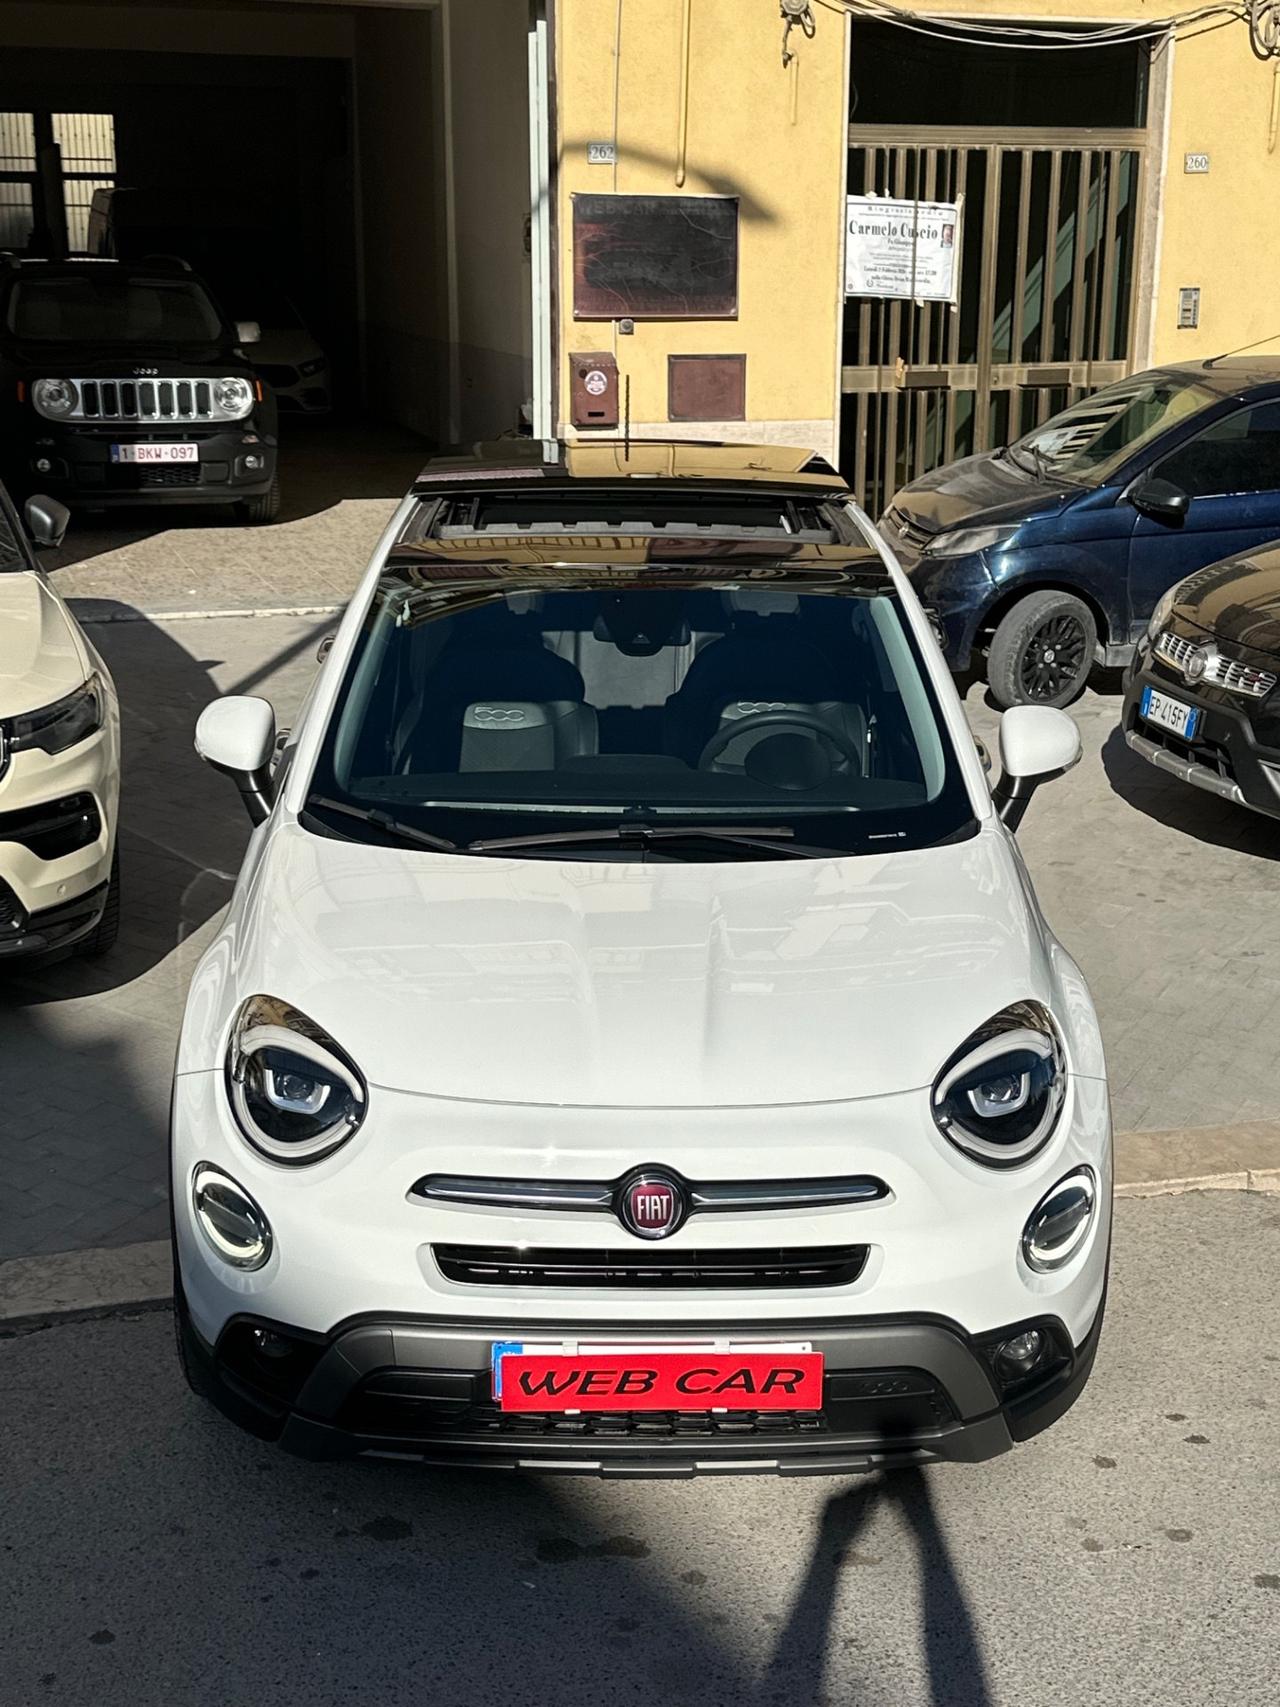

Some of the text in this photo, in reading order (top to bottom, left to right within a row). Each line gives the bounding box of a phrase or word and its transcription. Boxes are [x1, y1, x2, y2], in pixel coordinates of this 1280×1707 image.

[591, 146, 614, 159] 262
[1188, 157, 1207, 169] 260
[849, 220, 897, 237] Carmelo
[636, 1195, 670, 1220] FIAT
[518, 1368, 806, 1396] WEB CAR
